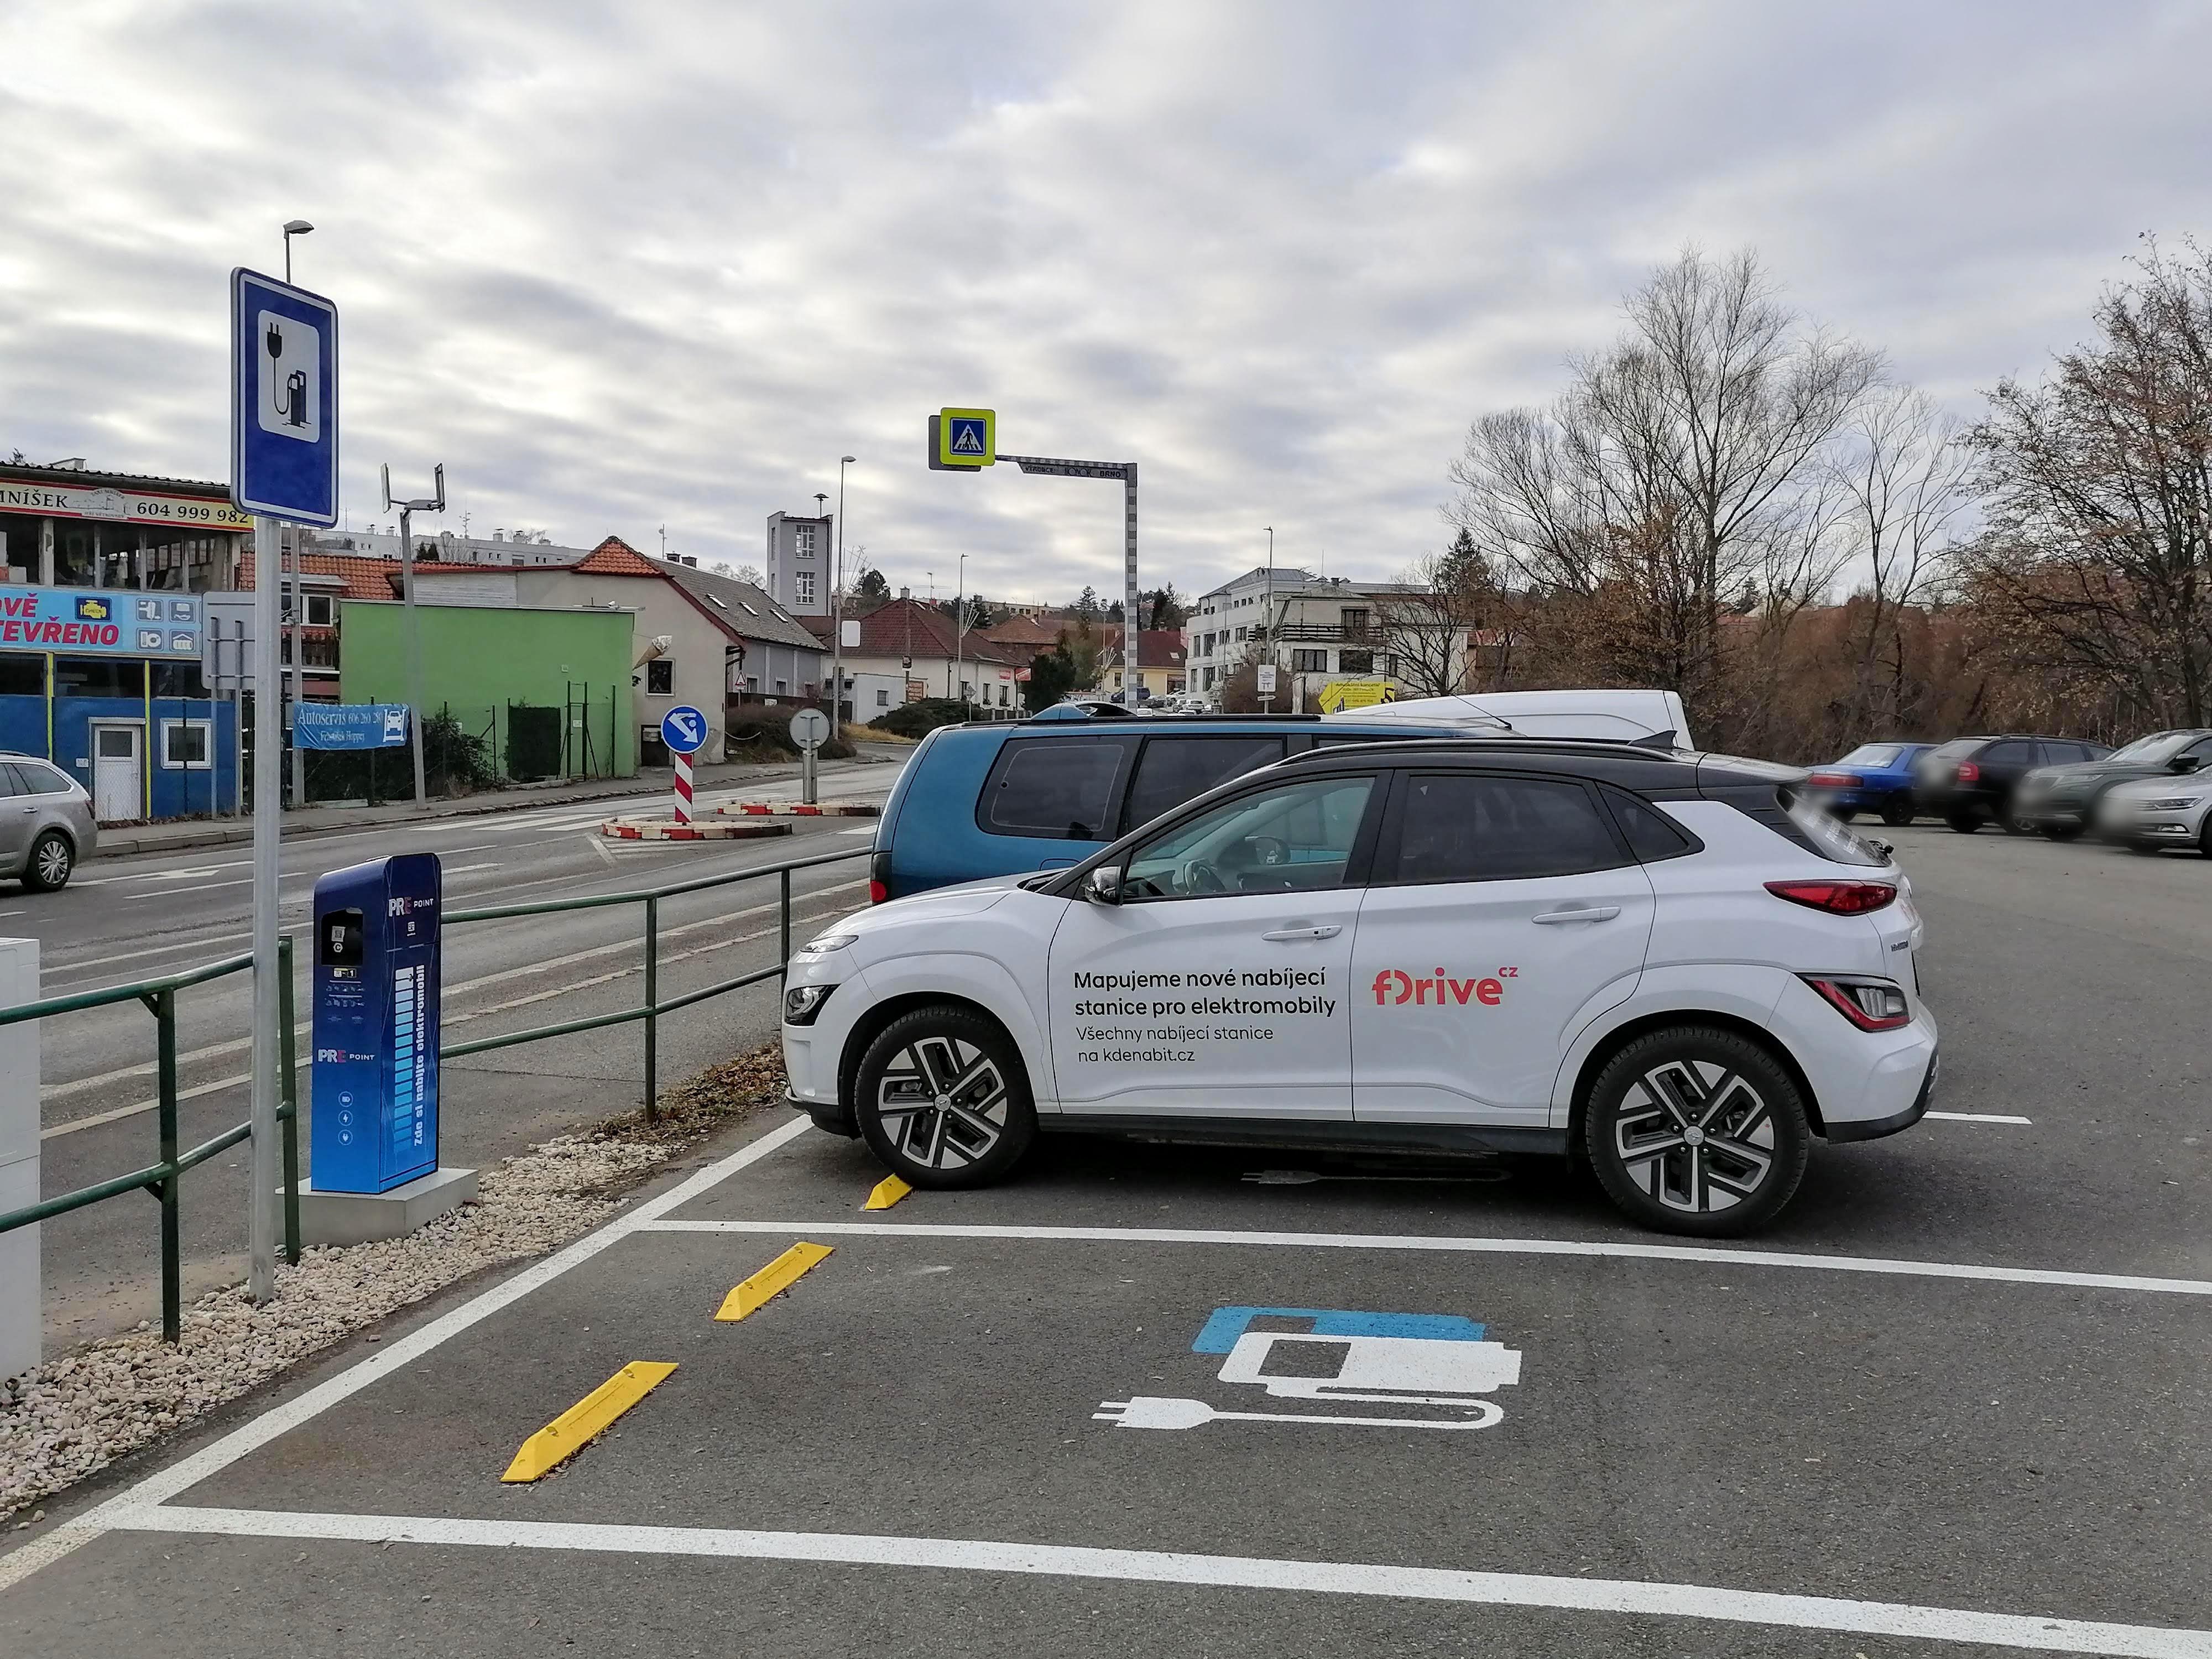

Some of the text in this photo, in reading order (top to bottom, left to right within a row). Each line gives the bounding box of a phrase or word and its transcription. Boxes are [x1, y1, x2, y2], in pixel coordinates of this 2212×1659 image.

[137, 503, 248, 524] 604 999 982
[0, 592, 39, 618] VĚ
[298, 708, 346, 726] Autoservis
[389, 896, 434, 917] PRE POINT
[1074, 967, 1326, 992] Mapujeme nové nabíjecí
[1371, 967, 1503, 1005] fDrive
[1075, 996, 1336, 1018] stanice pro elektromobily
[1076, 1025, 1274, 1043] Všechny nabíjecí stanice
[318, 1049, 346, 1063] PRE
[1079, 1048, 1195, 1062] na kdenabit.cz
[414, 1121, 423, 1146] Zde
